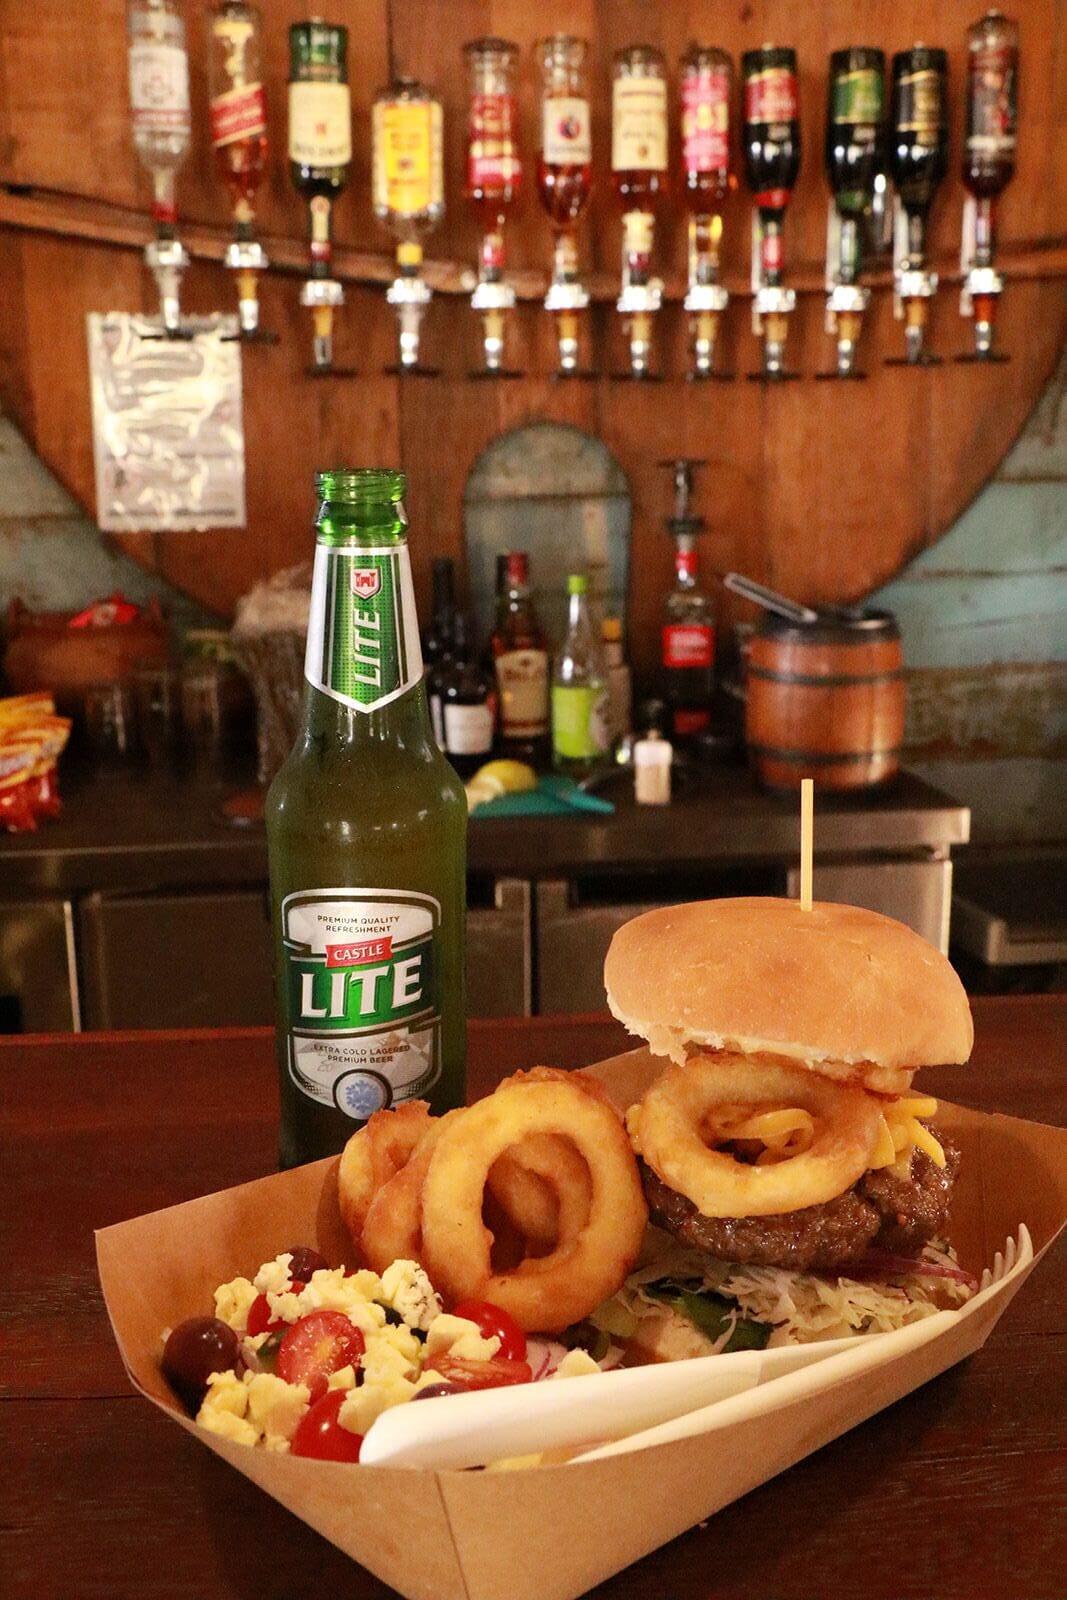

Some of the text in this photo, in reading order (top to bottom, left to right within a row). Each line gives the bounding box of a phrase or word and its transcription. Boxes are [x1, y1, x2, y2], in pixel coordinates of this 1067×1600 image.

[354, 608, 381, 688] LITE
[317, 915, 400, 925] PREMIUM QUALITY
[326, 925, 391, 933] REFRESHMENT
[333, 944, 384, 961] CASTLE
[300, 955, 423, 1018] LITE
[313, 1044, 410, 1055] EXTRA COLD LAGERED
[327, 1055, 393, 1064] PREMIUM BEER
